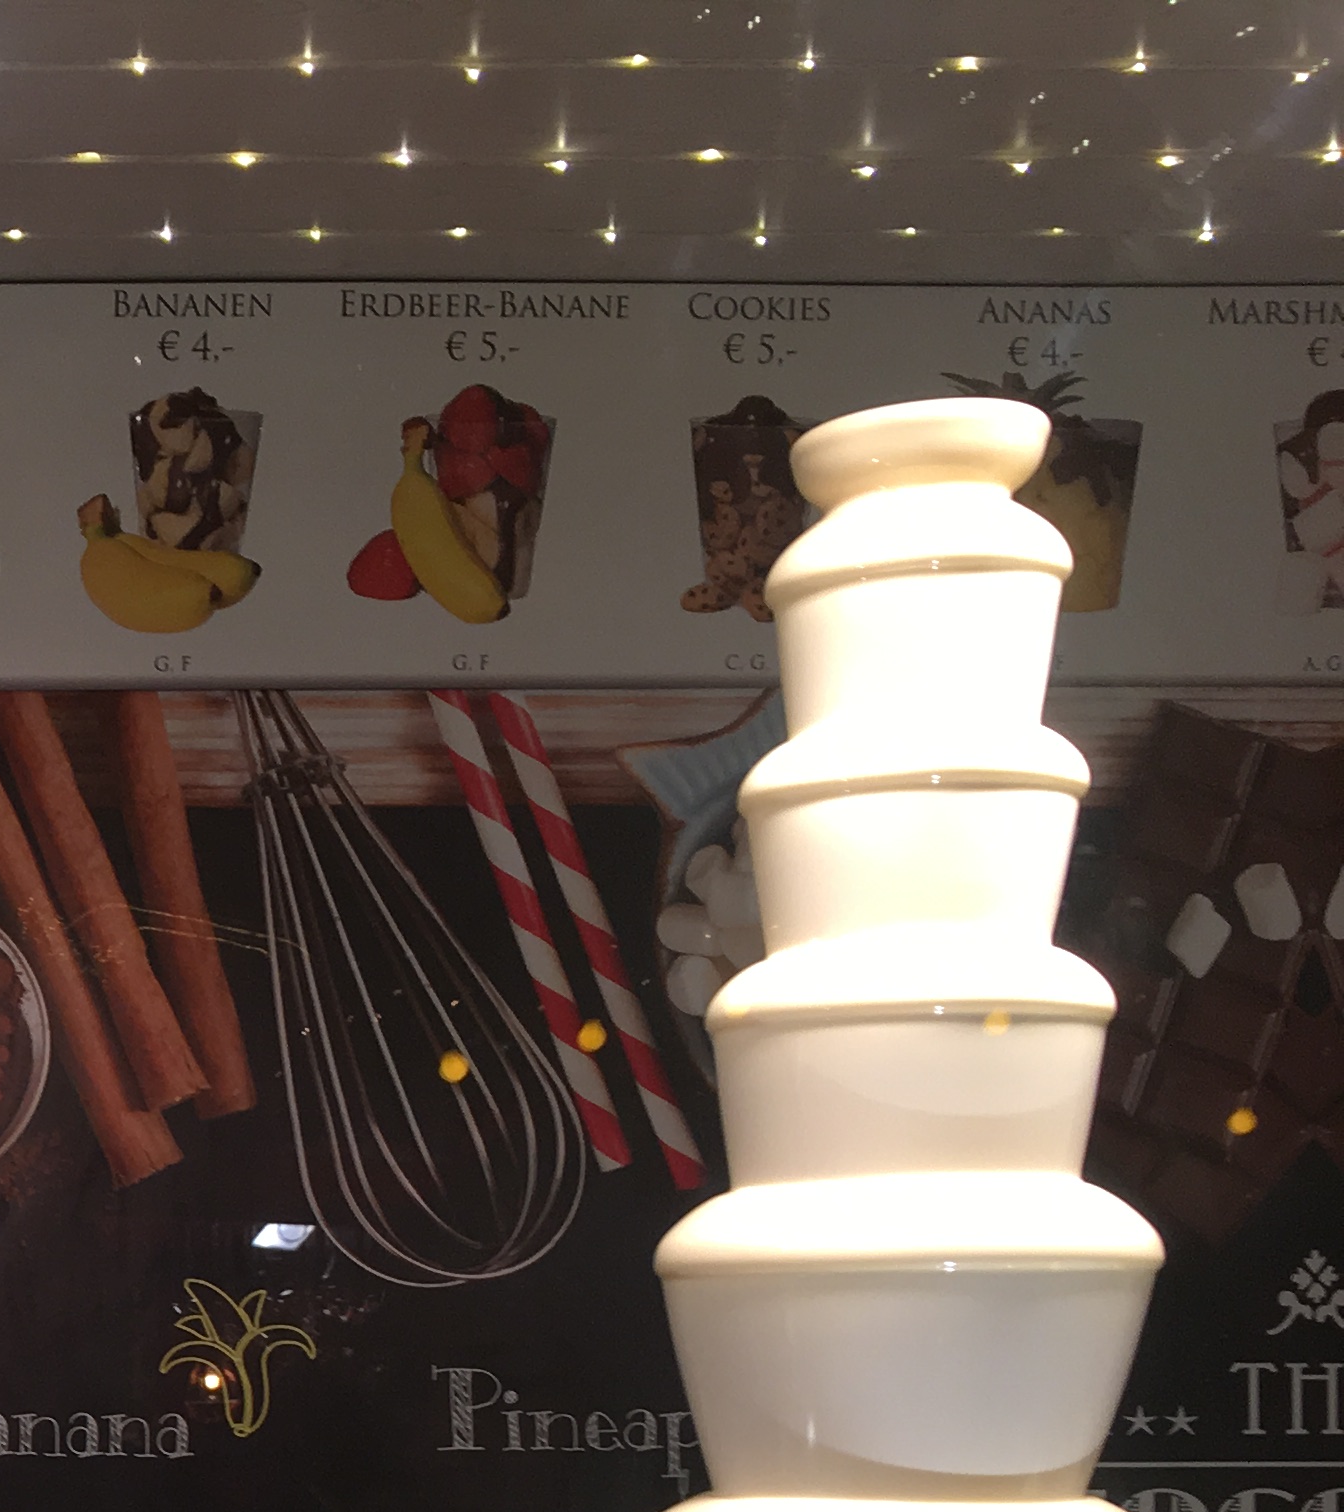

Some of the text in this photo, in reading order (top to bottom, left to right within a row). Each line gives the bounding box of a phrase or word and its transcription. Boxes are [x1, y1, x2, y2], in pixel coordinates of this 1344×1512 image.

[112, 289, 273, 318] BANANEN
[339, 289, 630, 320] ERDBEER-BANANE
[687, 292, 831, 322] COOKIES
[977, 296, 1113, 326] ANANAS
[157, 329, 180, 362] €
[444, 330, 468, 362] €
[722, 332, 746, 364] €
[1008, 336, 1031, 367] €
